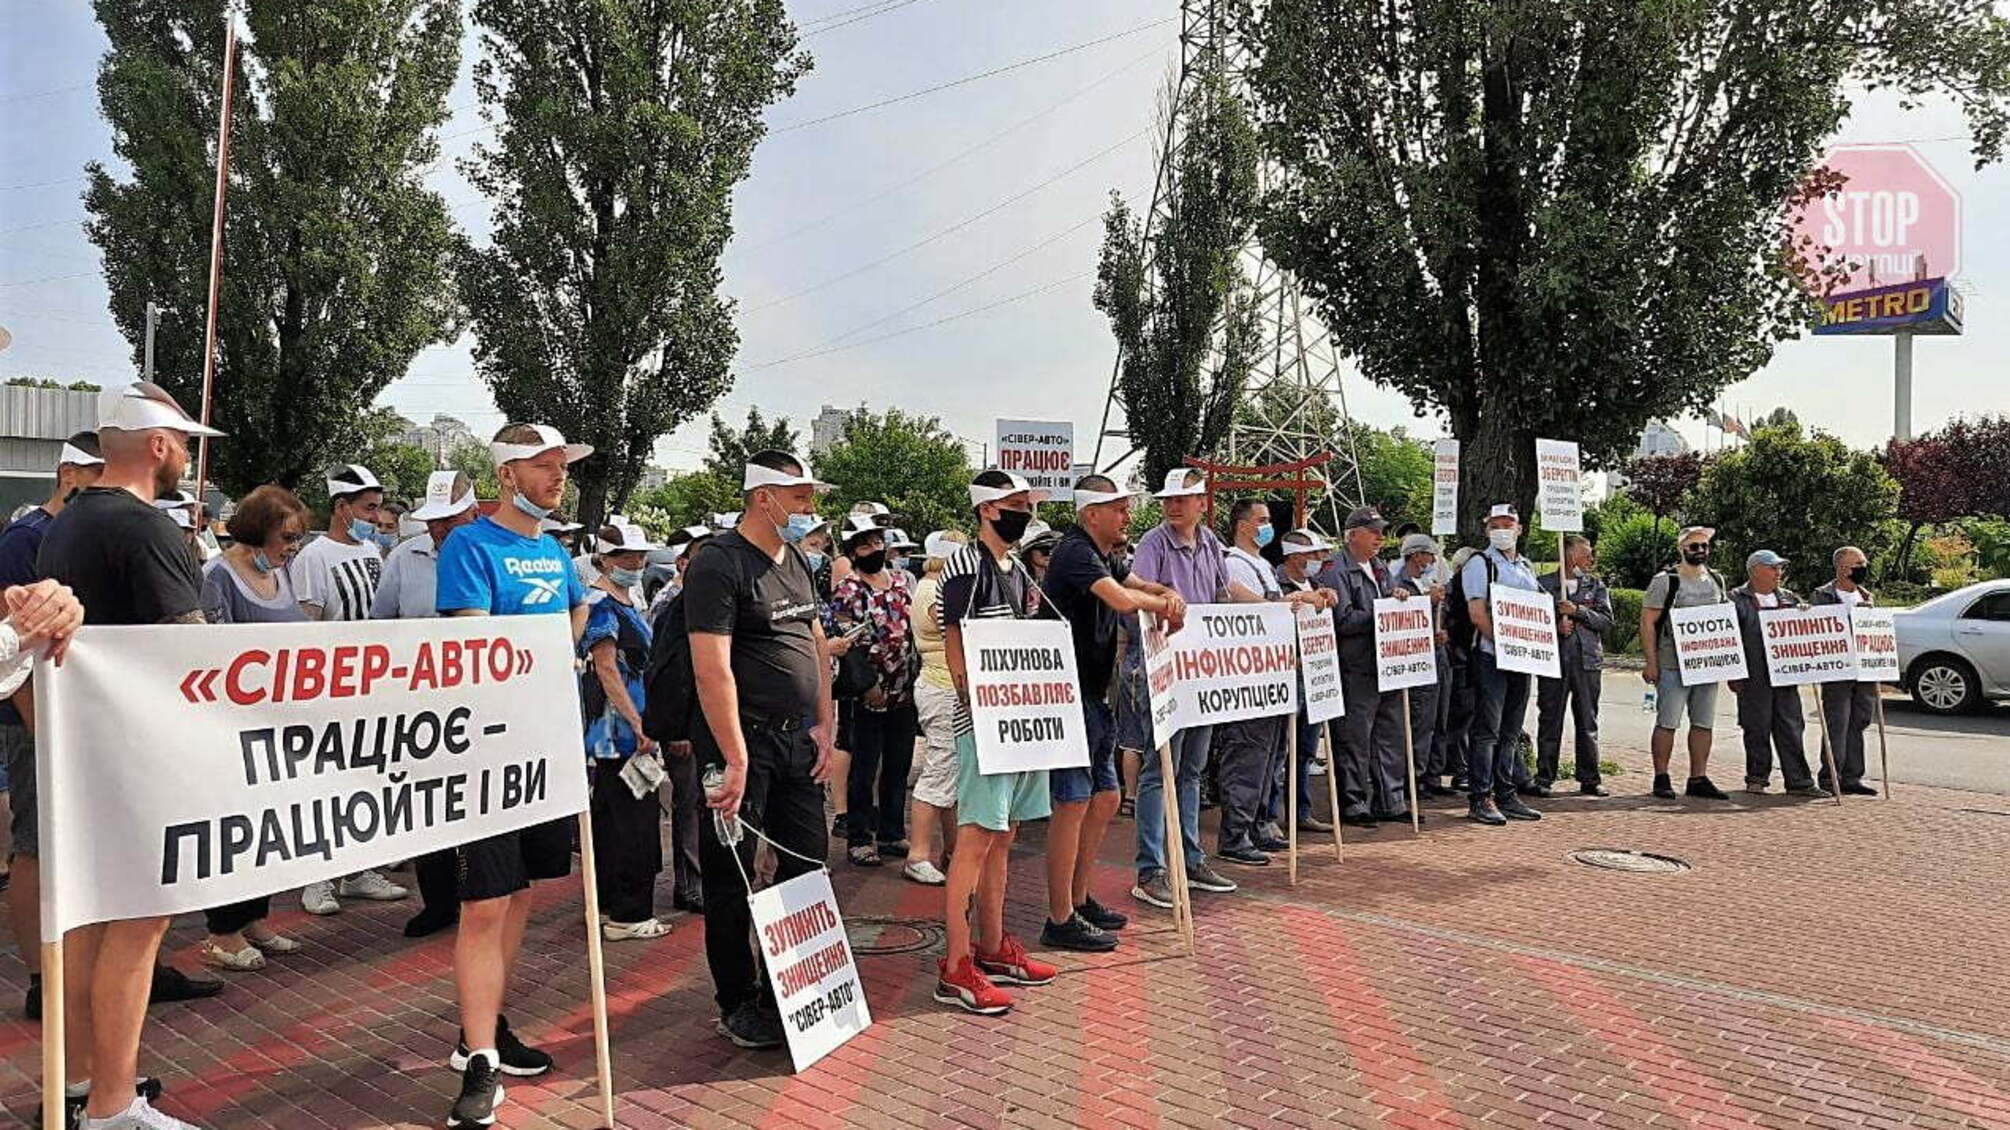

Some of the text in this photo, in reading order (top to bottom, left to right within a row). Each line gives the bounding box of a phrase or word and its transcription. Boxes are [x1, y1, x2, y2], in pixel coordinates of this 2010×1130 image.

[1822, 288, 1930, 326] METRO
[1001, 449, 1070, 473] ПРАЦЮЄ
[1378, 610, 1429, 632] ЗУПИНІТЬ
[1497, 600, 1551, 625] ЗУПИНІТЬ
[1203, 615, 1266, 638] TOYOTA
[1499, 621, 1553, 645] ЗНИЩЕННЯ
[1677, 618, 1735, 634] TOYOTA
[1766, 616, 1845, 639] ЗУПИНІТЬ
[980, 648, 1064, 671] ЛІХУНОВА
[1379, 636, 1430, 659] ЗНИЩЕННЯ
[1771, 639, 1848, 660] ЗНИЩЕННЯ
[179, 637, 534, 705] «СІВЕР-АВТО»
[1175, 644, 1296, 680] ІНФІКОВАНА
[1684, 652, 1741, 670] КОРУПЦІЄЮ
[976, 682, 1075, 707] ПОЗБАВЛЯЄ
[1198, 683, 1289, 713] КОРУПЦІЄЮ
[999, 717, 1064, 743] РОБОТИ
[240, 707, 471, 785] ПРАЦЮЄ
[161, 772, 468, 885] ПРАЦЮЙТЕ
[480, 769, 490, 815] І
[502, 759, 546, 810] ВИ
[764, 901, 837, 957] ЗУПИНІТЬ
[777, 940, 849, 998] ЗНИЩЕННЯ
